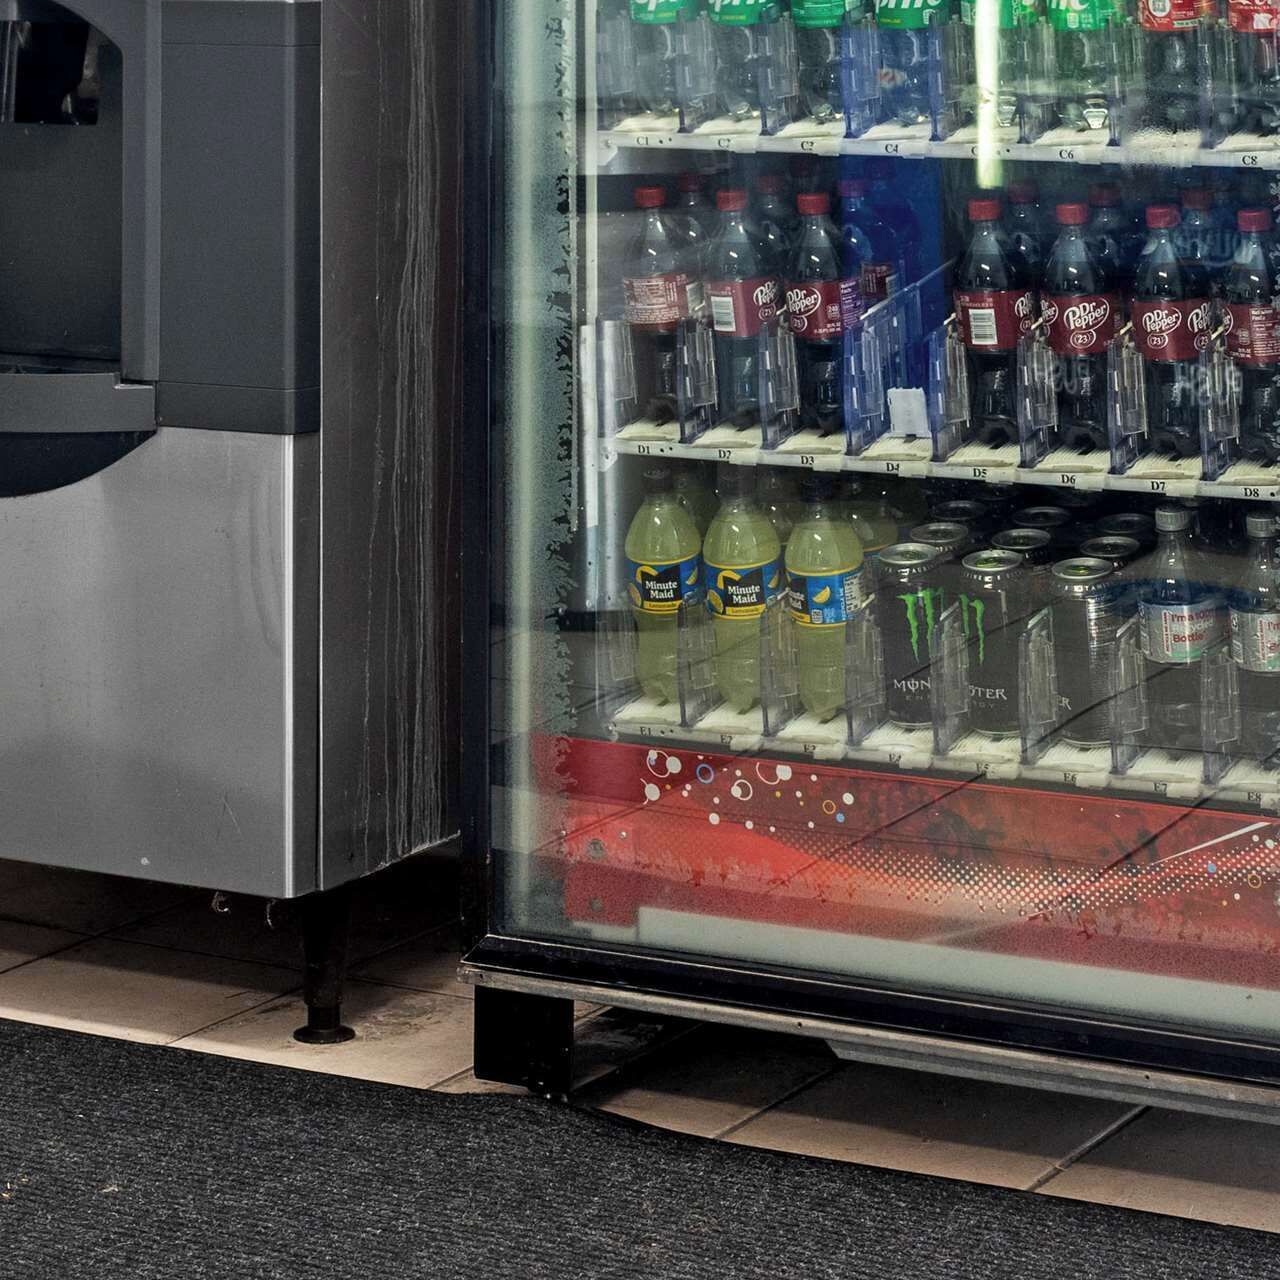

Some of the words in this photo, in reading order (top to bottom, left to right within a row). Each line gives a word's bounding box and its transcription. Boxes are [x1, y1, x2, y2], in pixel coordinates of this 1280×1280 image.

[885, 144, 898, 154] C4
[1059, 149, 1074, 159] C6
[1242, 155, 1257, 165] C8
[794, 289, 807, 298] Dr
[787, 291, 818, 314] Pepper
[1079, 302, 1096, 315] Dr
[1068, 305, 1106, 329] Pepper
[1154, 310, 1168, 320] Dr
[1147, 312, 1178, 332] Pepper
[1077, 334, 1088, 343] 23
[637, 444, 650, 454] D1
[801, 455, 814, 465] D3
[973, 469, 987, 478] D5
[1061, 475, 1076, 485] D6
[1151, 482, 1165, 491] D7
[1244, 487, 1259, 497] D8
[645, 581, 677, 591] Minute
[728, 585, 760, 596] Minute
[650, 589, 674, 599] Maid
[733, 594, 756, 604] Maid
[1248, 792, 1262, 802] E8
